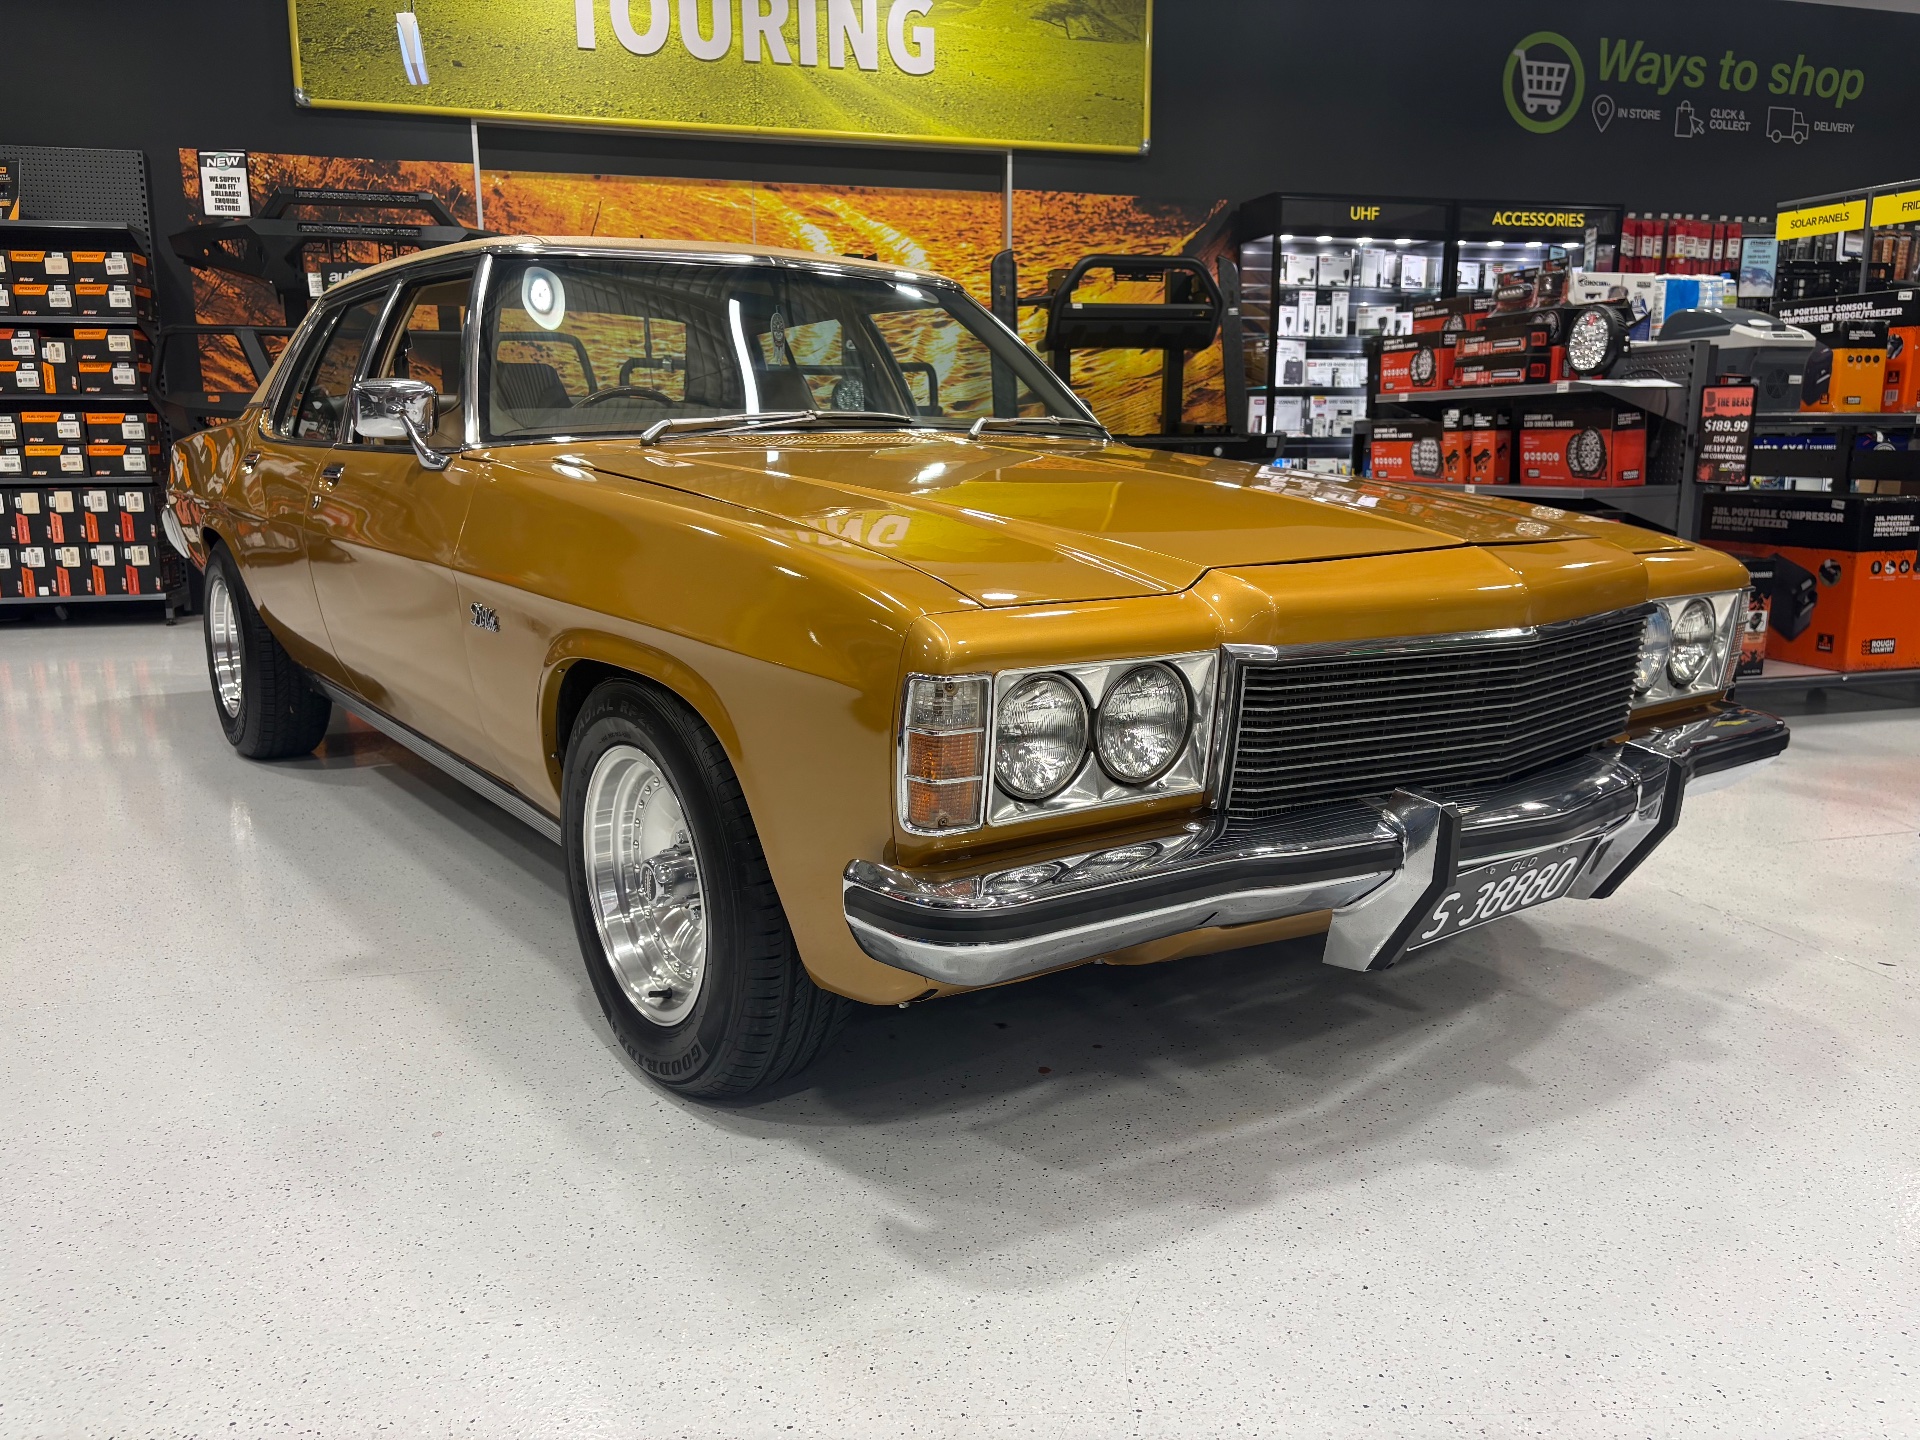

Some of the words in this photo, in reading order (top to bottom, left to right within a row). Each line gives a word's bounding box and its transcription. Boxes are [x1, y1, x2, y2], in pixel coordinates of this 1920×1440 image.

[1600, 37, 1707, 96] Ways
[1718, 51, 1758, 92] to
[1768, 54, 1864, 109] shop
[1617, 108, 1628, 118] IN
[1628, 109, 1661, 121] STORE
[1710, 108, 1737, 120] CLICK
[1738, 110, 1745, 120] &
[1709, 119, 1751, 132] COLLECT
[1814, 121, 1855, 133] DELIVERY
[206, 156, 240, 167] NEW
[1350, 206, 1380, 221] UHF
[1492, 211, 1585, 228] ACCESSORIES
[1790, 217, 1817, 229] SOLAR
[1818, 212, 1850, 225] PANELS
[1779, 309, 1791, 317] 14L
[1794, 306, 1833, 316] PORTABLE
[1835, 302, 1873, 312] CONSOLE
[1780, 314, 1829, 324] OMPRESSOR
[1831, 307, 1903, 321] FRIDGE/FREEZER
[1717, 397, 1729, 407] THE
[1704, 419, 1748, 433] $189.99
[1713, 435, 1725, 443] 150
[1725, 435, 1738, 443] PSI
[1704, 444, 1726, 453] HEAVY
[1726, 445, 1744, 453] DUTY
[1710, 453, 1746, 461] COMPRESSOR
[1732, 508, 1777, 518] PORTABLE
[1780, 510, 1844, 522] COMPRESSOR
[1711, 516, 1789, 529] FRIDGE/FREEZER
[1871, 639, 1894, 648] ROUGH
[1511, 856, 1538, 872] QLD
